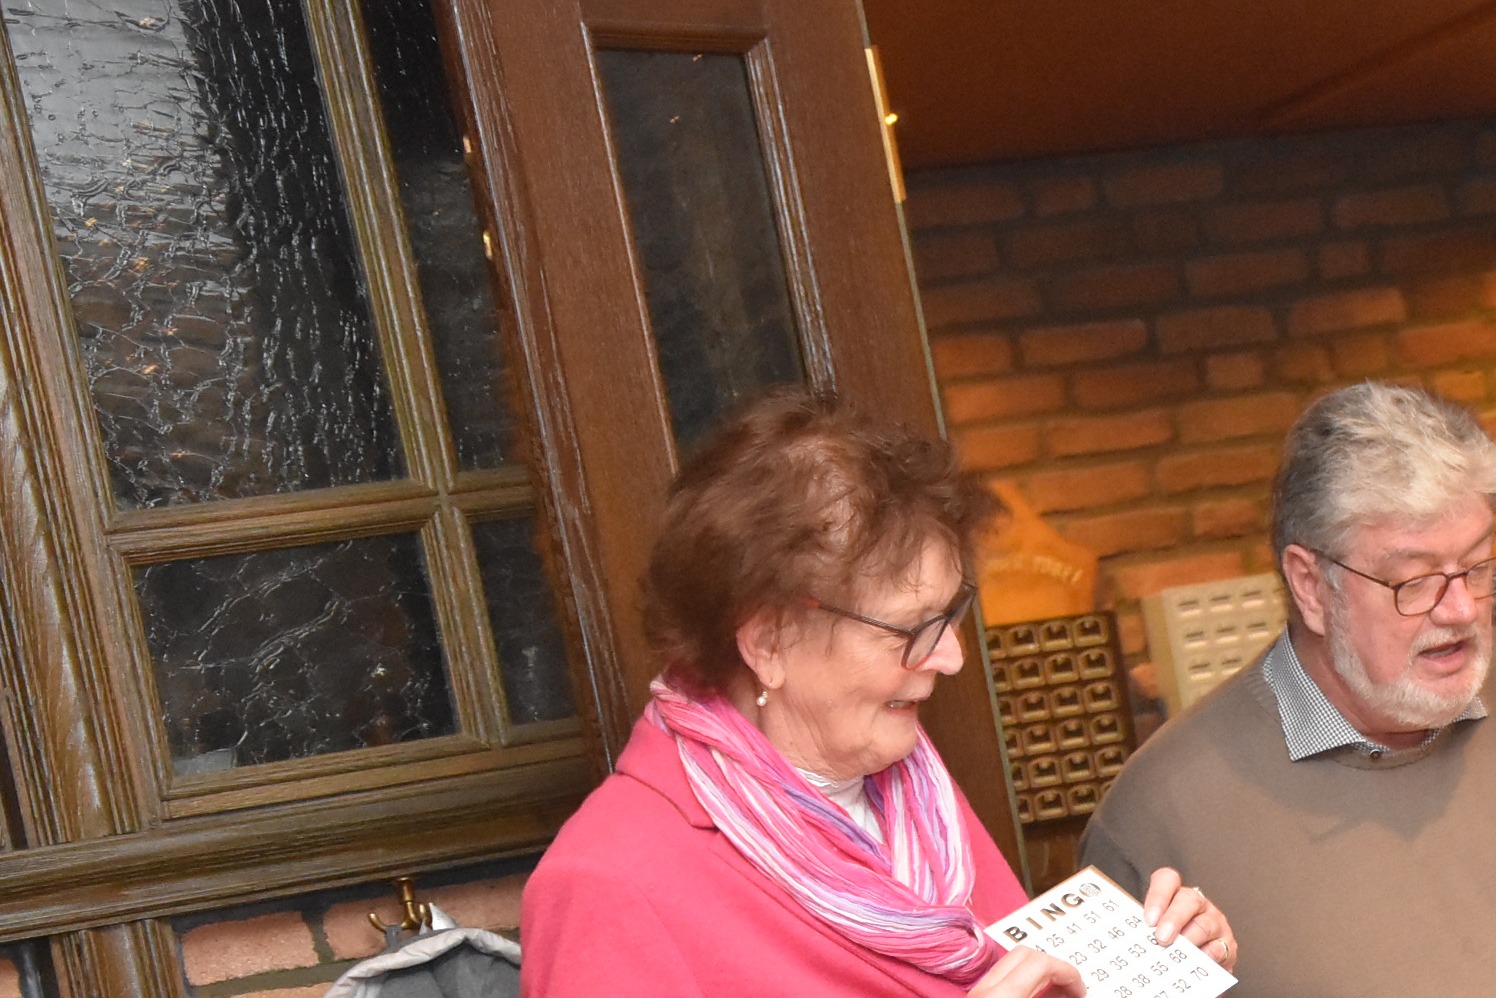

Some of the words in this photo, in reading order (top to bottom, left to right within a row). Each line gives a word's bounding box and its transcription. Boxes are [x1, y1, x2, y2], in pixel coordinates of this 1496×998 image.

[1003, 883, 1101, 943] BINGO
[1046, 934, 1064, 948] 25
[1066, 923, 1082, 934] 41
[1084, 911, 1102, 923] 51
[1102, 900, 1119, 911] 61
[1069, 952, 1087, 965] 23
[1088, 939, 1107, 953] 32
[1108, 927, 1124, 939] 46
[1125, 916, 1142, 928] 64
[1091, 968, 1109, 981] 29
[1110, 956, 1128, 970] 35
[1128, 944, 1146, 957] 53
[1114, 986, 1132, 998] 28
[1132, 974, 1151, 988] 38
[1150, 961, 1168, 976] 55
[1169, 949, 1187, 963] 68
[1172, 979, 1191, 993] 52
[1190, 966, 1209, 981] 70
